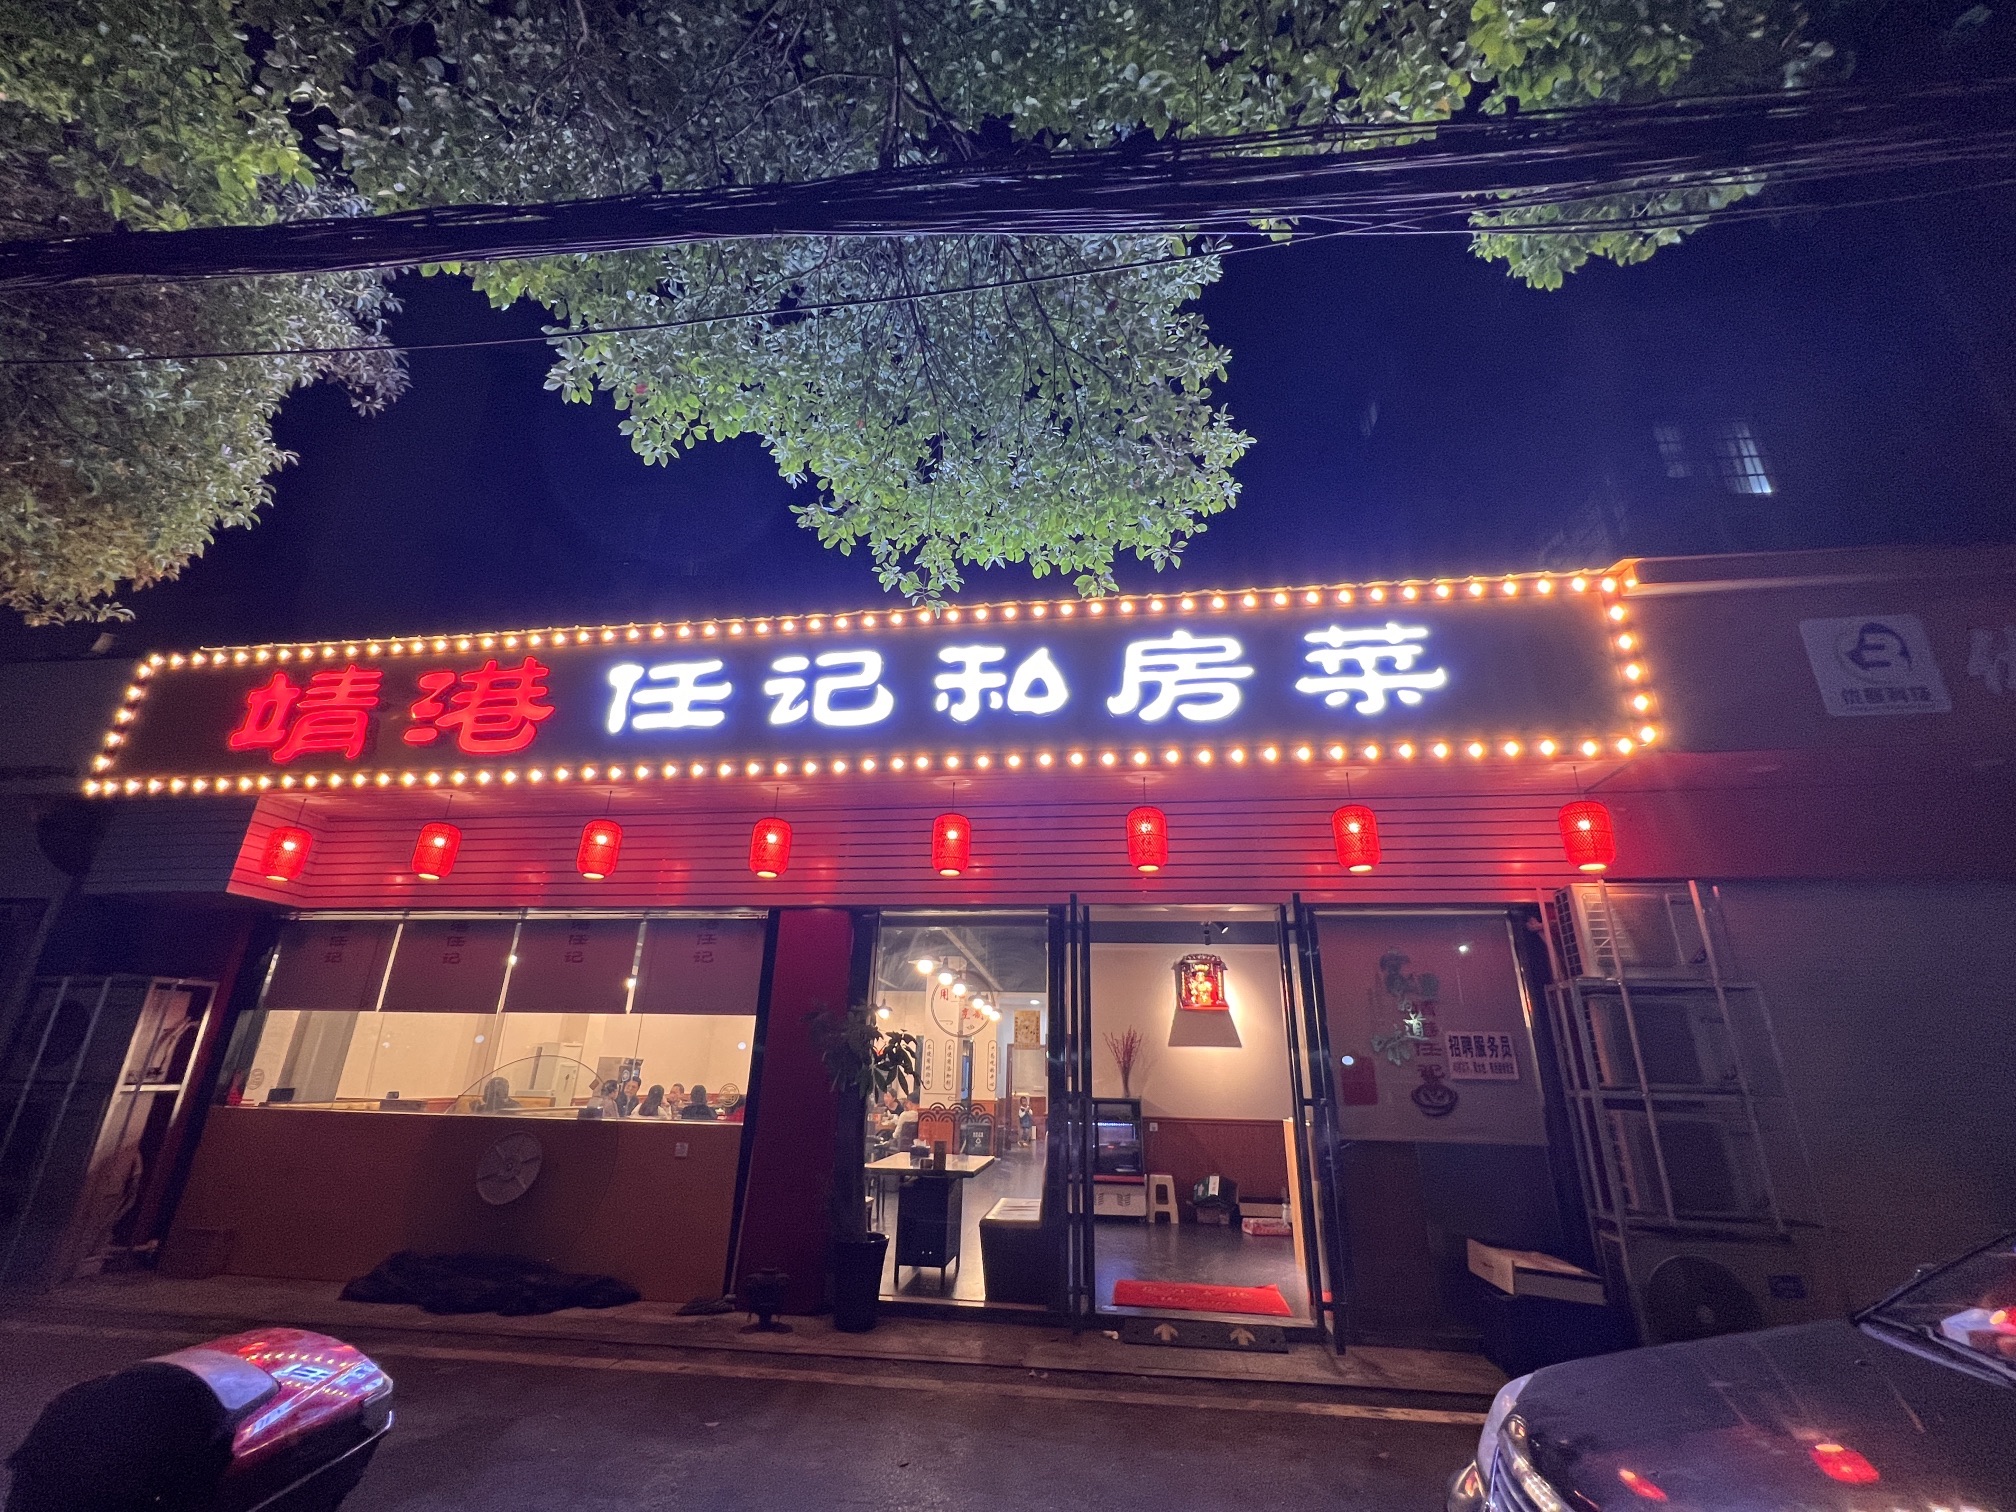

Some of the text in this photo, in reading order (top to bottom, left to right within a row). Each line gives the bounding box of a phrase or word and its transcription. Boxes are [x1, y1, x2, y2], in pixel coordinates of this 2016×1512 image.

[1448, 1034, 1513, 1058] 招聘服务员
